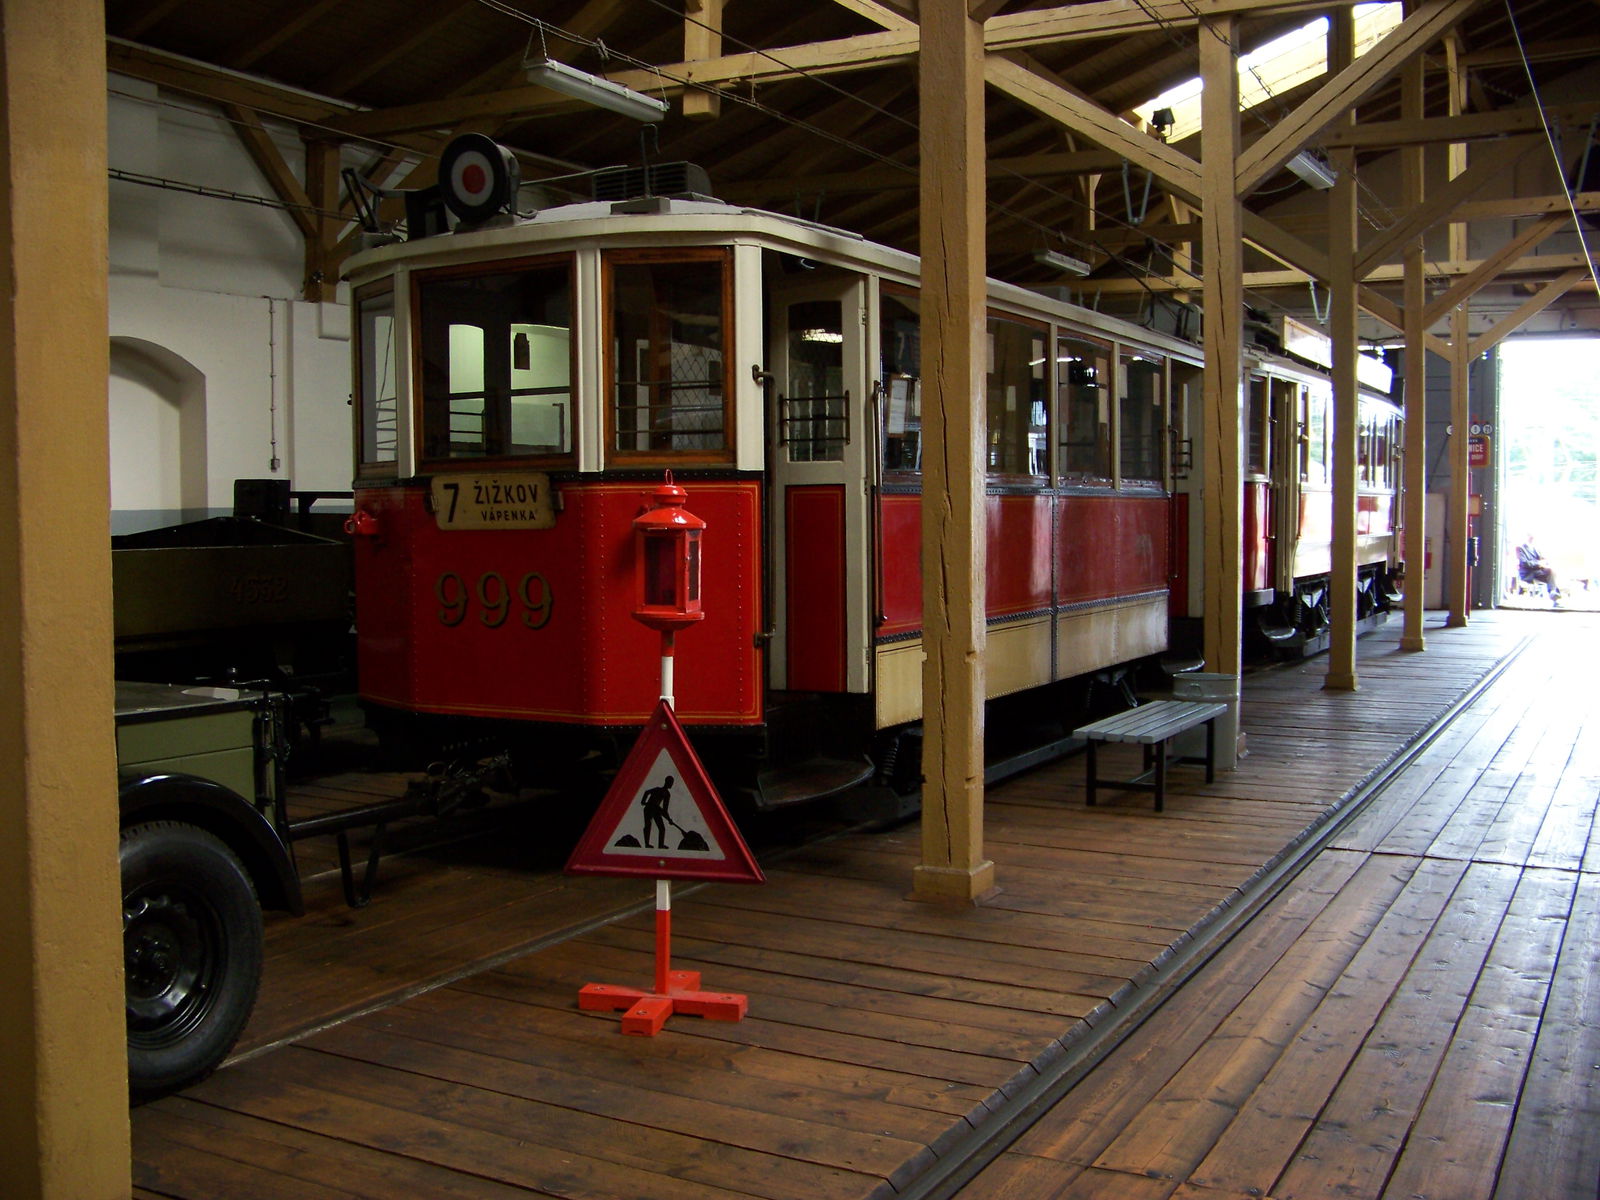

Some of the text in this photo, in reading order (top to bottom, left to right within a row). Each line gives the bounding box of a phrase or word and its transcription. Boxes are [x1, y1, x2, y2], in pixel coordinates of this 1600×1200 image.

[443, 483, 460, 523] 7
[473, 480, 538, 505] ŽIŽKOV
[481, 507, 536, 521] VÁPENKA
[434, 571, 554, 630] 999
